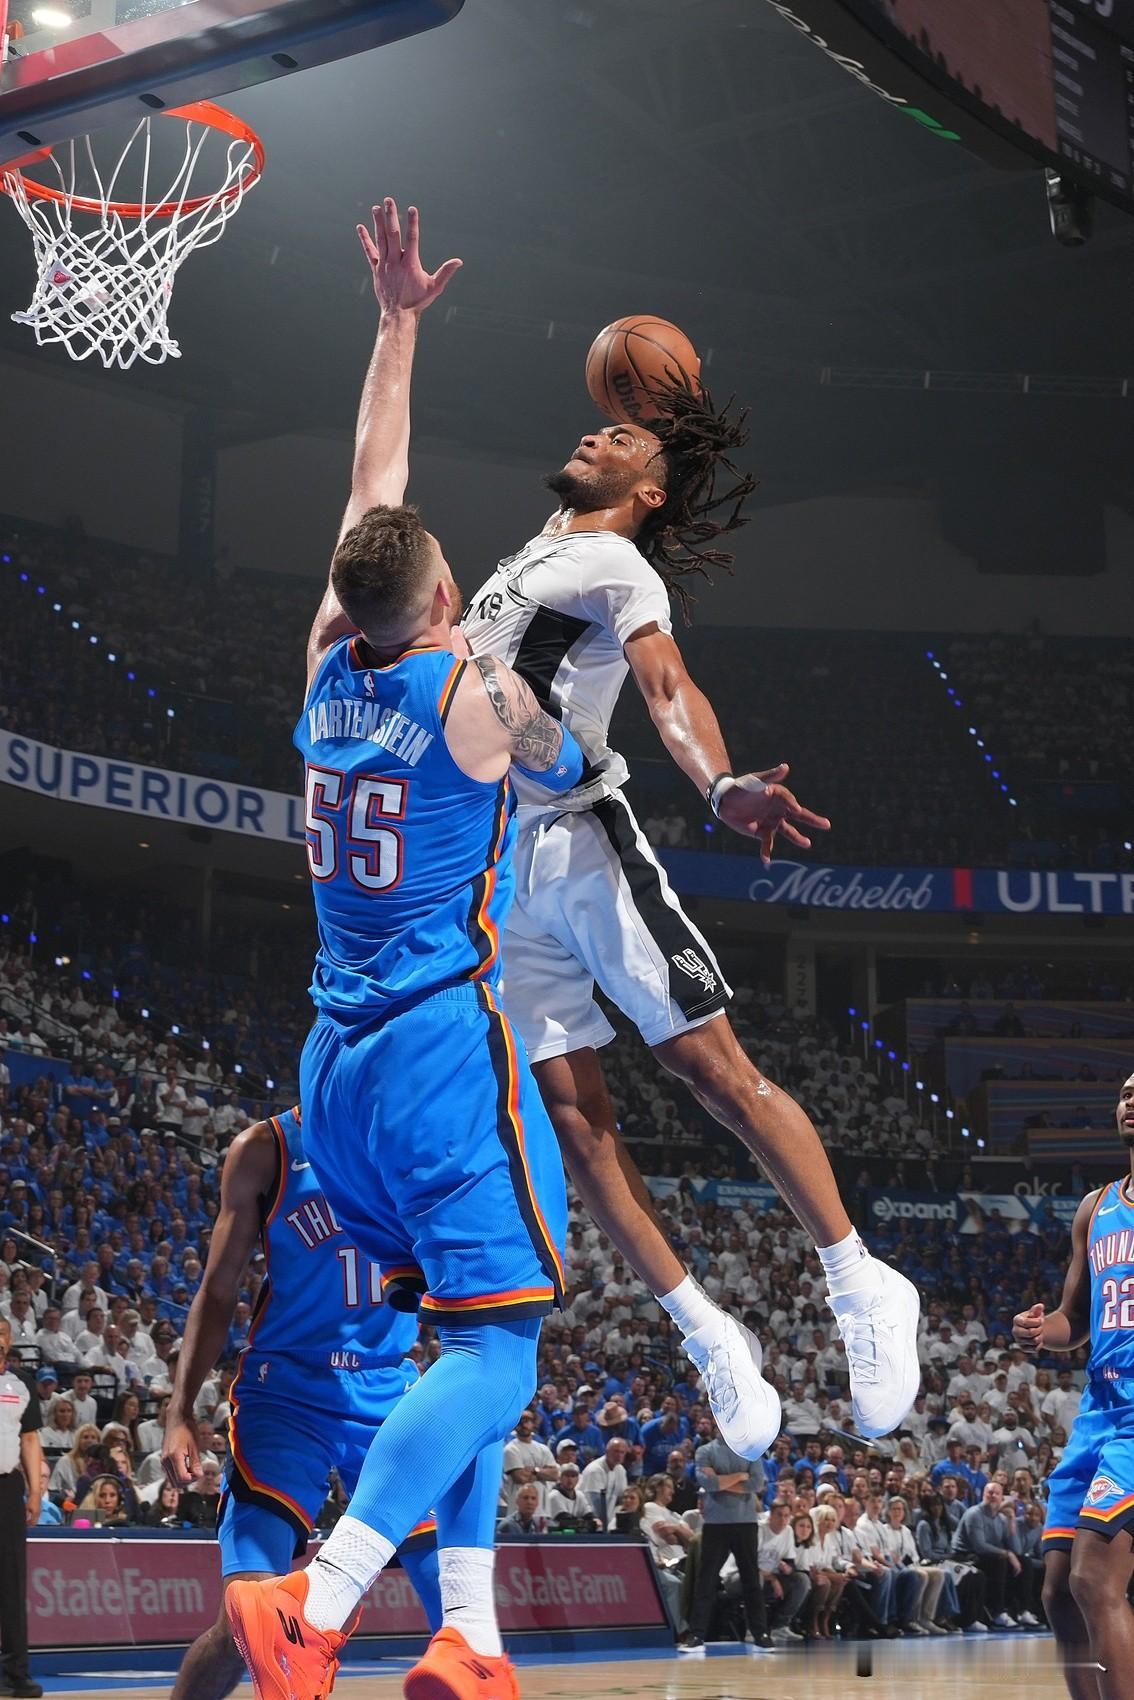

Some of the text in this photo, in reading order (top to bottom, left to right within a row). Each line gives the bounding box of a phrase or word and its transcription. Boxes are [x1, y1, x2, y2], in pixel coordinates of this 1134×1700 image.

[308, 698, 434, 768] HARTENSTEIN
[6, 738, 265, 833] SUPERIOR
[305, 763, 409, 894] 55
[749, 859, 935, 911] Michelob
